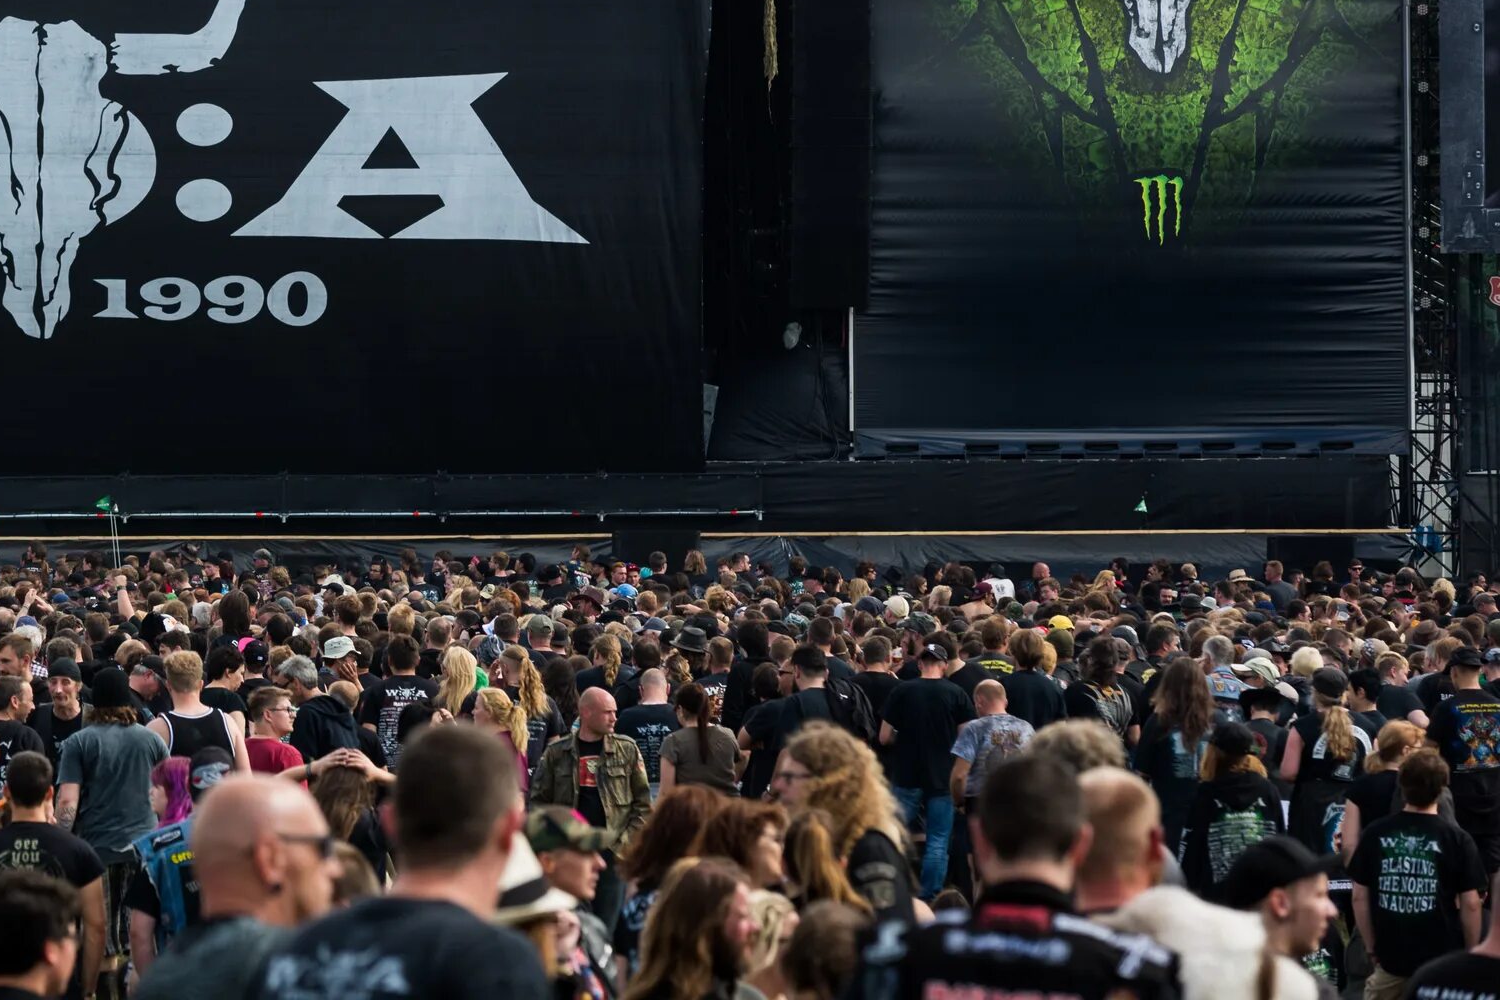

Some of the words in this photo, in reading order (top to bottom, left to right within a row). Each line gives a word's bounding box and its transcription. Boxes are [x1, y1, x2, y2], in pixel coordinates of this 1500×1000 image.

[92, 271, 328, 327] 1990
[1381, 856, 1435, 876] BLASTING
[1379, 876, 1400, 891] THE
[1401, 876, 1437, 893] NORTH
